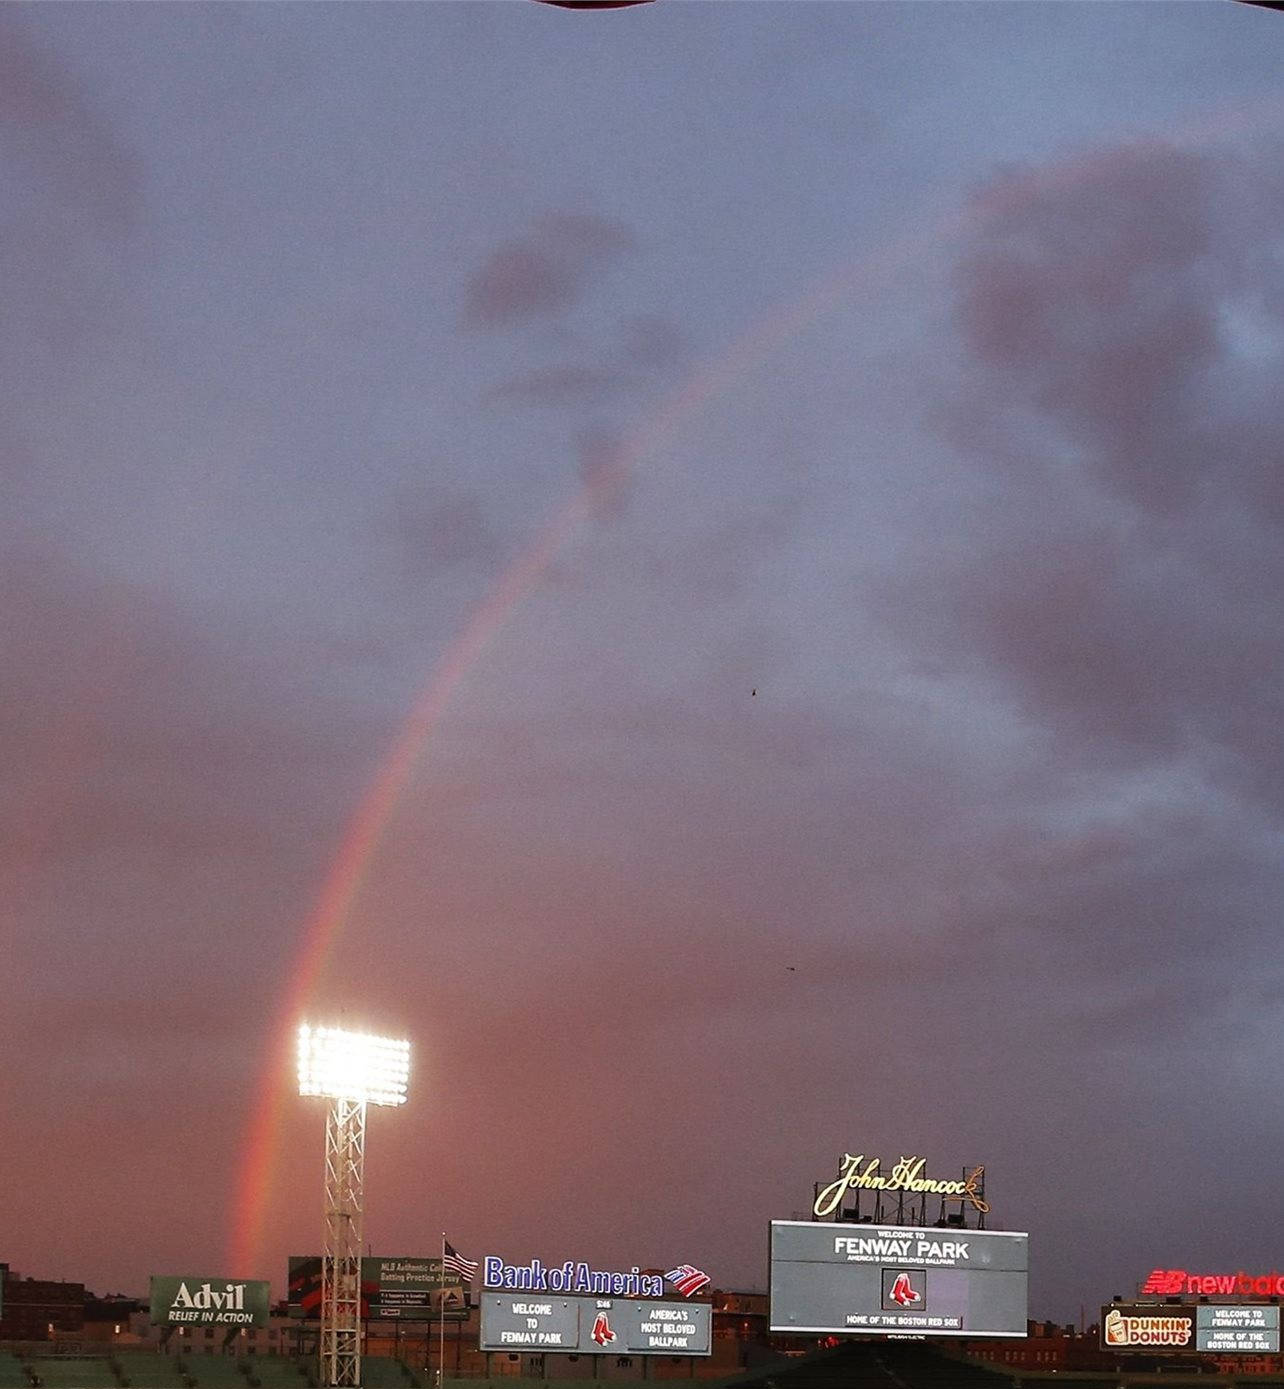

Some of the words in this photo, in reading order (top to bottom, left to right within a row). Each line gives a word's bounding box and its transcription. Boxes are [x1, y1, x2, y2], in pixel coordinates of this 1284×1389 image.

[814, 1152, 886, 1216] John
[886, 1155, 991, 1213] Hancock
[877, 1231, 914, 1239] WELCOME
[834, 1238, 912, 1256] FENWAY
[917, 1241, 969, 1259] PARK
[484, 1256, 547, 1290] Bank
[551, 1261, 574, 1291] of
[575, 1263, 663, 1297] America
[171, 1282, 244, 1309] Advil
[512, 1303, 552, 1315] WELCOME
[1215, 1310, 1251, 1318] WELCOME
[1252, 1310, 1263, 1318] TO
[168, 1311, 199, 1321] RELIEF
[202, 1312, 213, 1321] IN
[216, 1312, 253, 1323] ACTION
[650, 1310, 688, 1321] AMERICA'S
[847, 1315, 868, 1324] HOME
[869, 1316, 880, 1324] OF
[882, 1316, 897, 1325] THE
[898, 1317, 927, 1326] BOSTON
[928, 1318, 942, 1326] RED
[944, 1318, 959, 1326] SOX
[527, 1318, 538, 1328] TO
[1130, 1319, 1190, 1330] DUNKIN'
[1212, 1318, 1243, 1326] FENWAY
[1245, 1318, 1265, 1326] PARK
[641, 1323, 661, 1333] MOST
[663, 1324, 696, 1334] BELOVED
[501, 1332, 537, 1343] FENWAY
[539, 1333, 561, 1343] PARK
[649, 1336, 687, 1347] BALLPARK
[1130, 1332, 1187, 1343] DONUTS
[1207, 1341, 1237, 1349] BOSTON
[1238, 1341, 1253, 1349] RED
[1255, 1341, 1270, 1349] SOX
